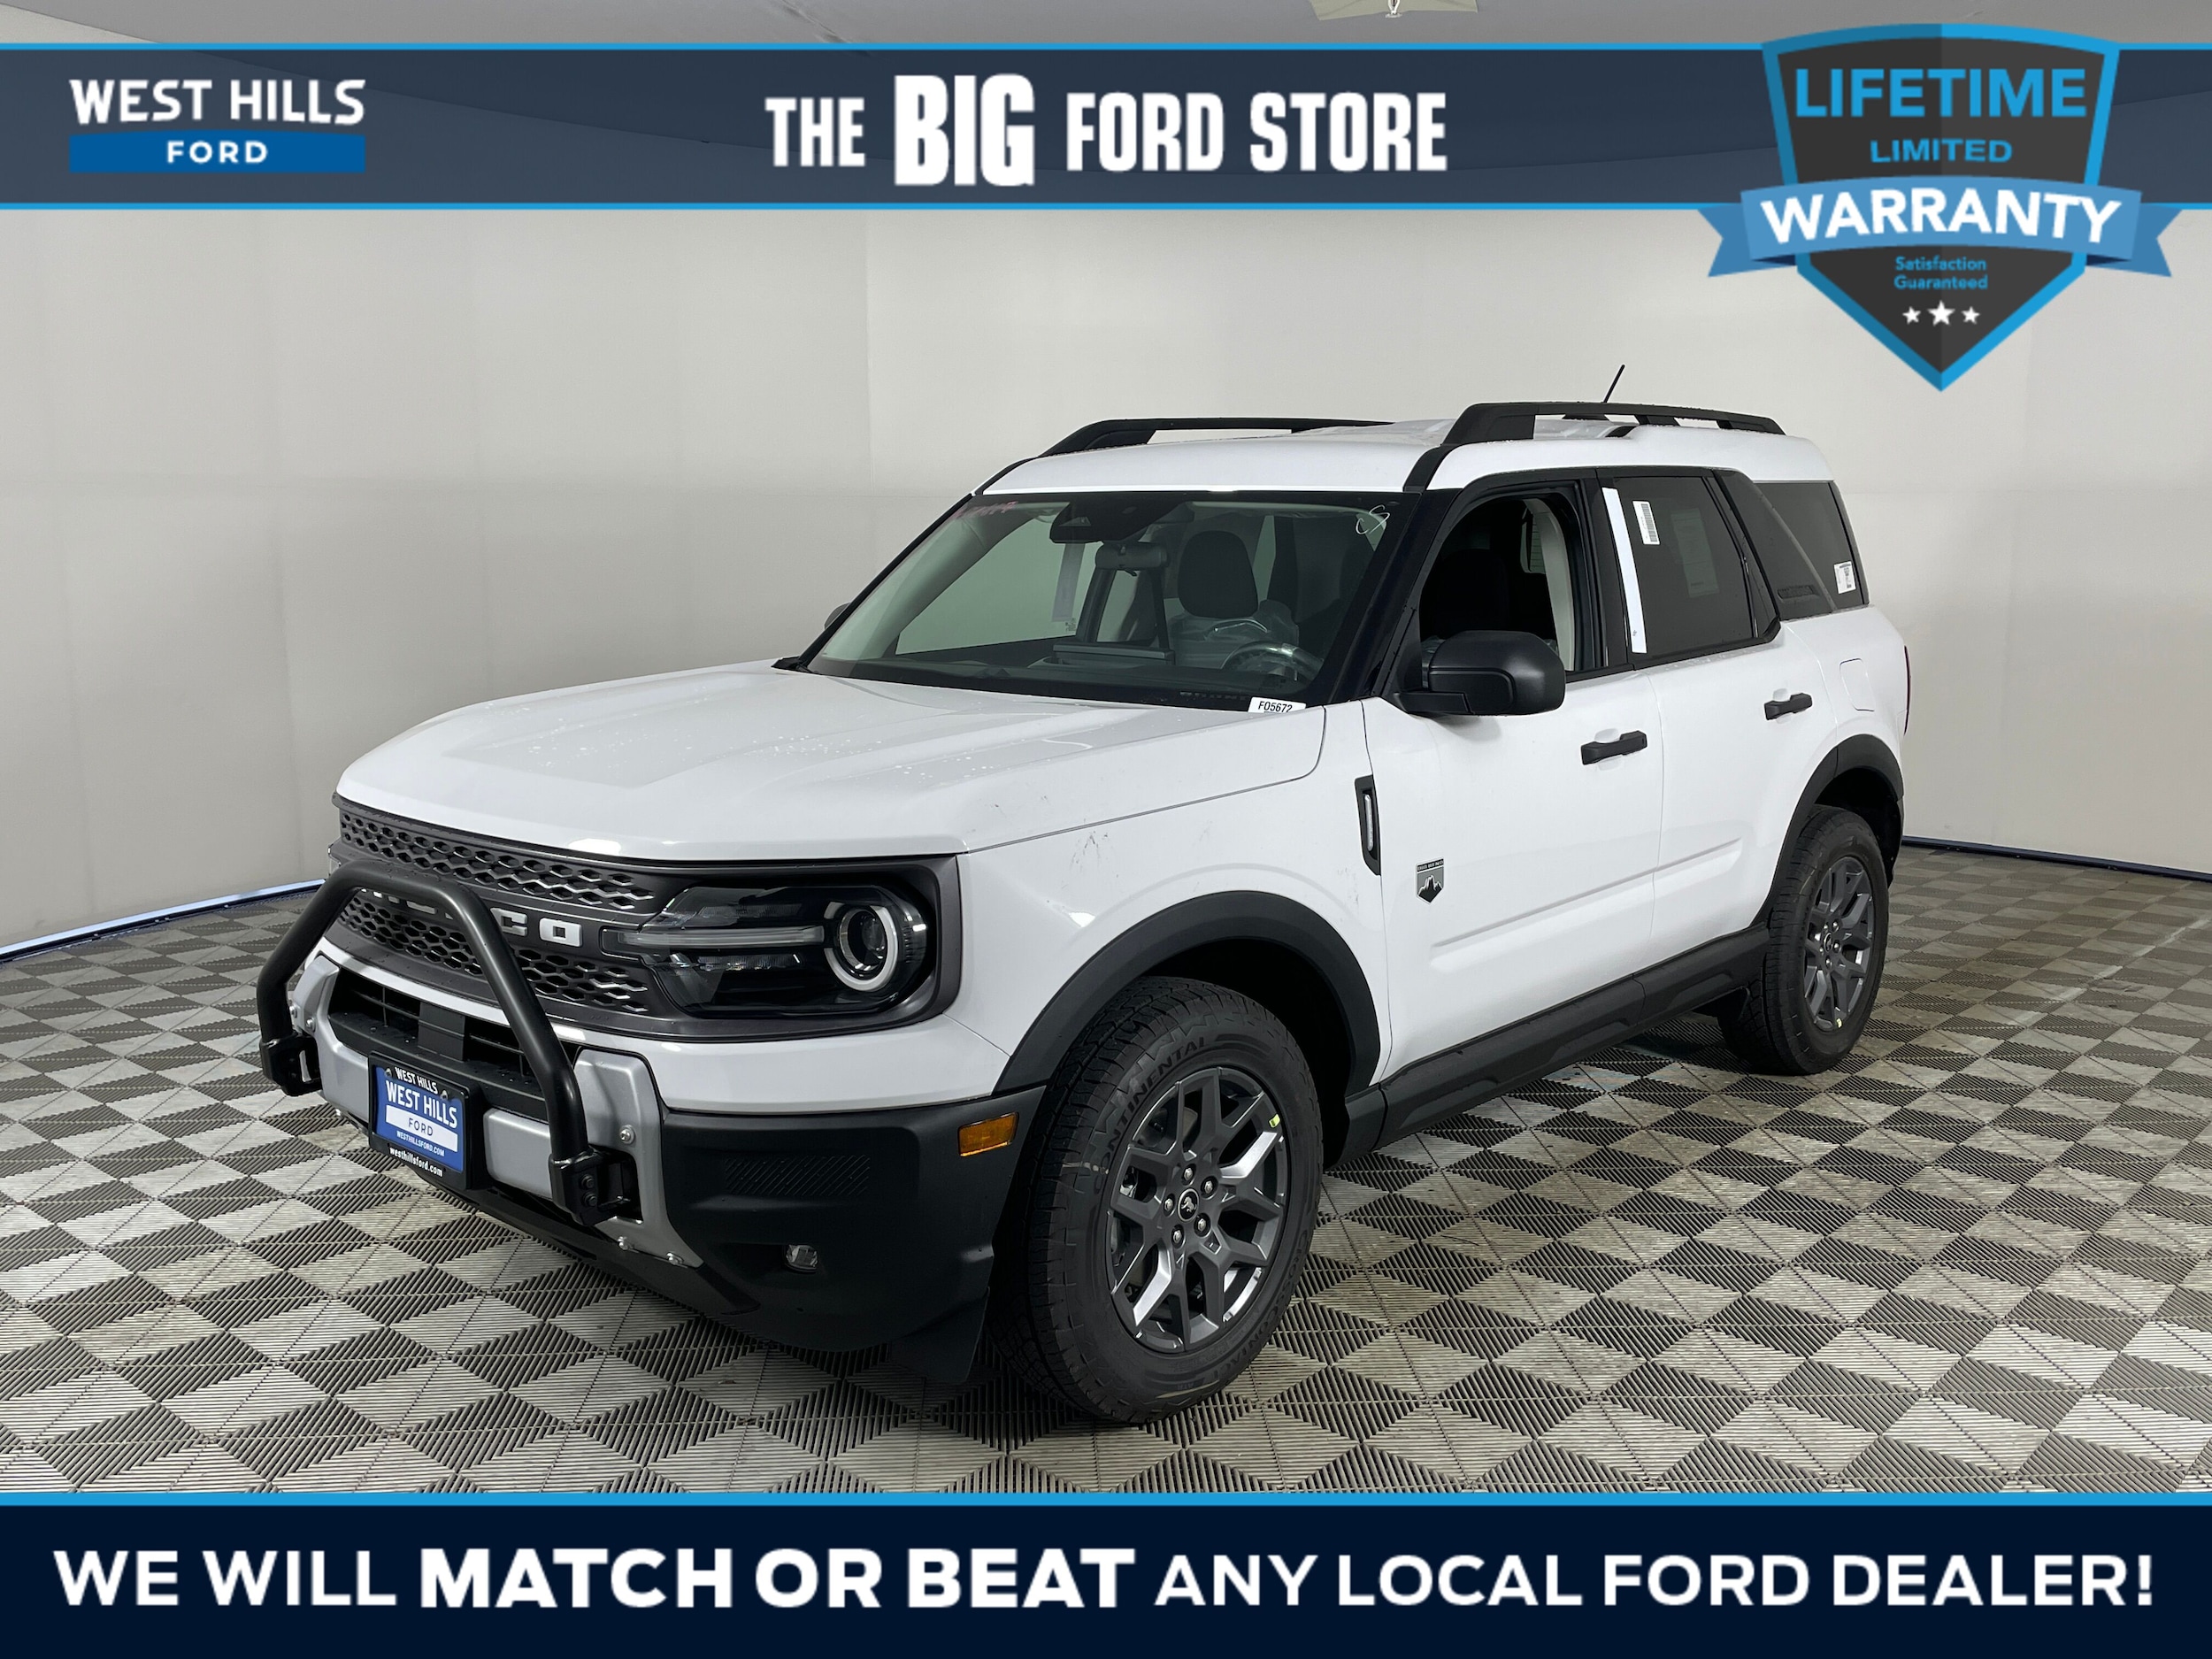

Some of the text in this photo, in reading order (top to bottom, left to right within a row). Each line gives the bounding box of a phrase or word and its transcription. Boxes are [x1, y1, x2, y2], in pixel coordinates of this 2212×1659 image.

[395, 1066, 438, 1094] WEST HILLS
[386, 1079, 457, 1129] WEST HILLS
[1094, 1036, 1205, 1194] CONTINENTAL
[408, 1118, 434, 1137] FORD
[396, 1130, 445, 1157] WESTHILLSFORD.COM
[389, 1147, 443, 1178] westhillsford.com
